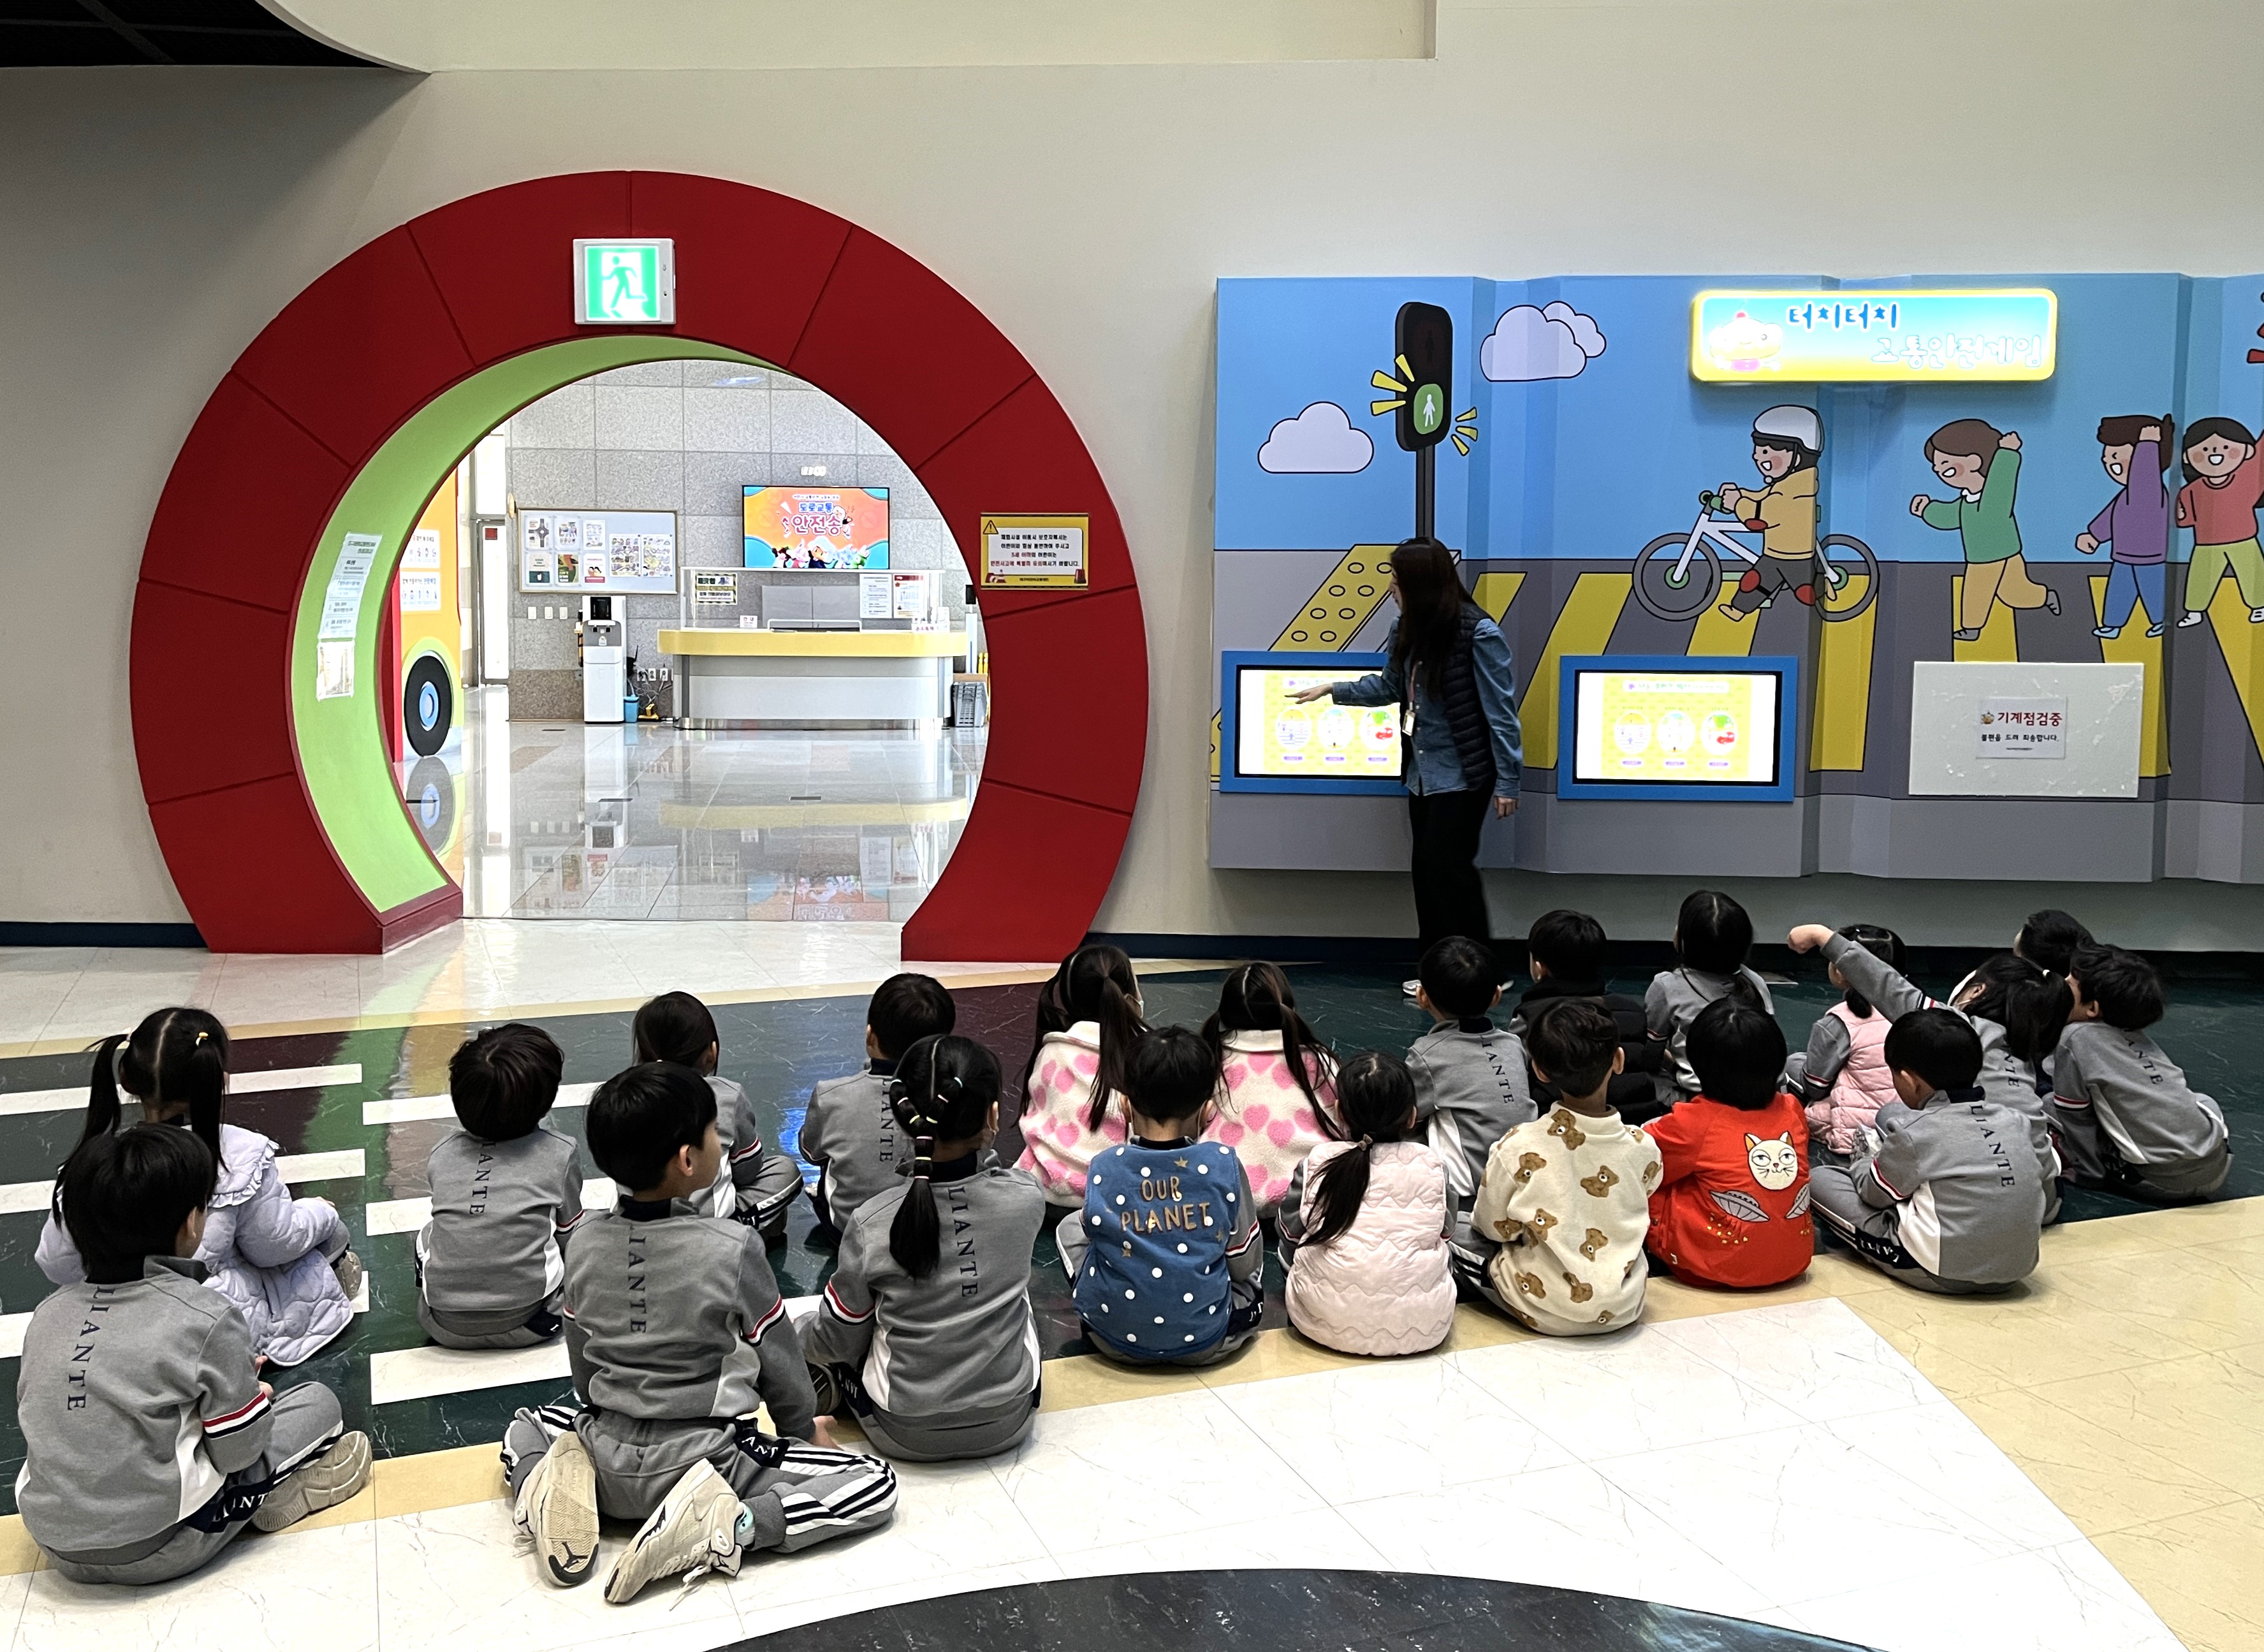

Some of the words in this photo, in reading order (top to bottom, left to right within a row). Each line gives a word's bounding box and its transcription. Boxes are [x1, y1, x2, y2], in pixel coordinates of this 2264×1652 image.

[1788, 303, 1898, 330] 터치터치
[1871, 333, 2041, 369] 교통안전게임
[800, 502, 833, 513] 도로교통
[792, 515, 843, 535] 안전송
[1997, 712, 2063, 727] 기계점검중
[1981, 734, 2001, 742] 불편을
[2022, 734, 2059, 742] 죄송합니다.
[1969, 1104, 2015, 1188] LIANTE
[469, 1140, 496, 1215] IANTE
[1141, 1176, 1181, 1201] OUR
[1120, 1202, 1211, 1234] PLANET
[948, 1186, 979, 1297] LIANTE
[67, 1285, 115, 1411] LIANTE
